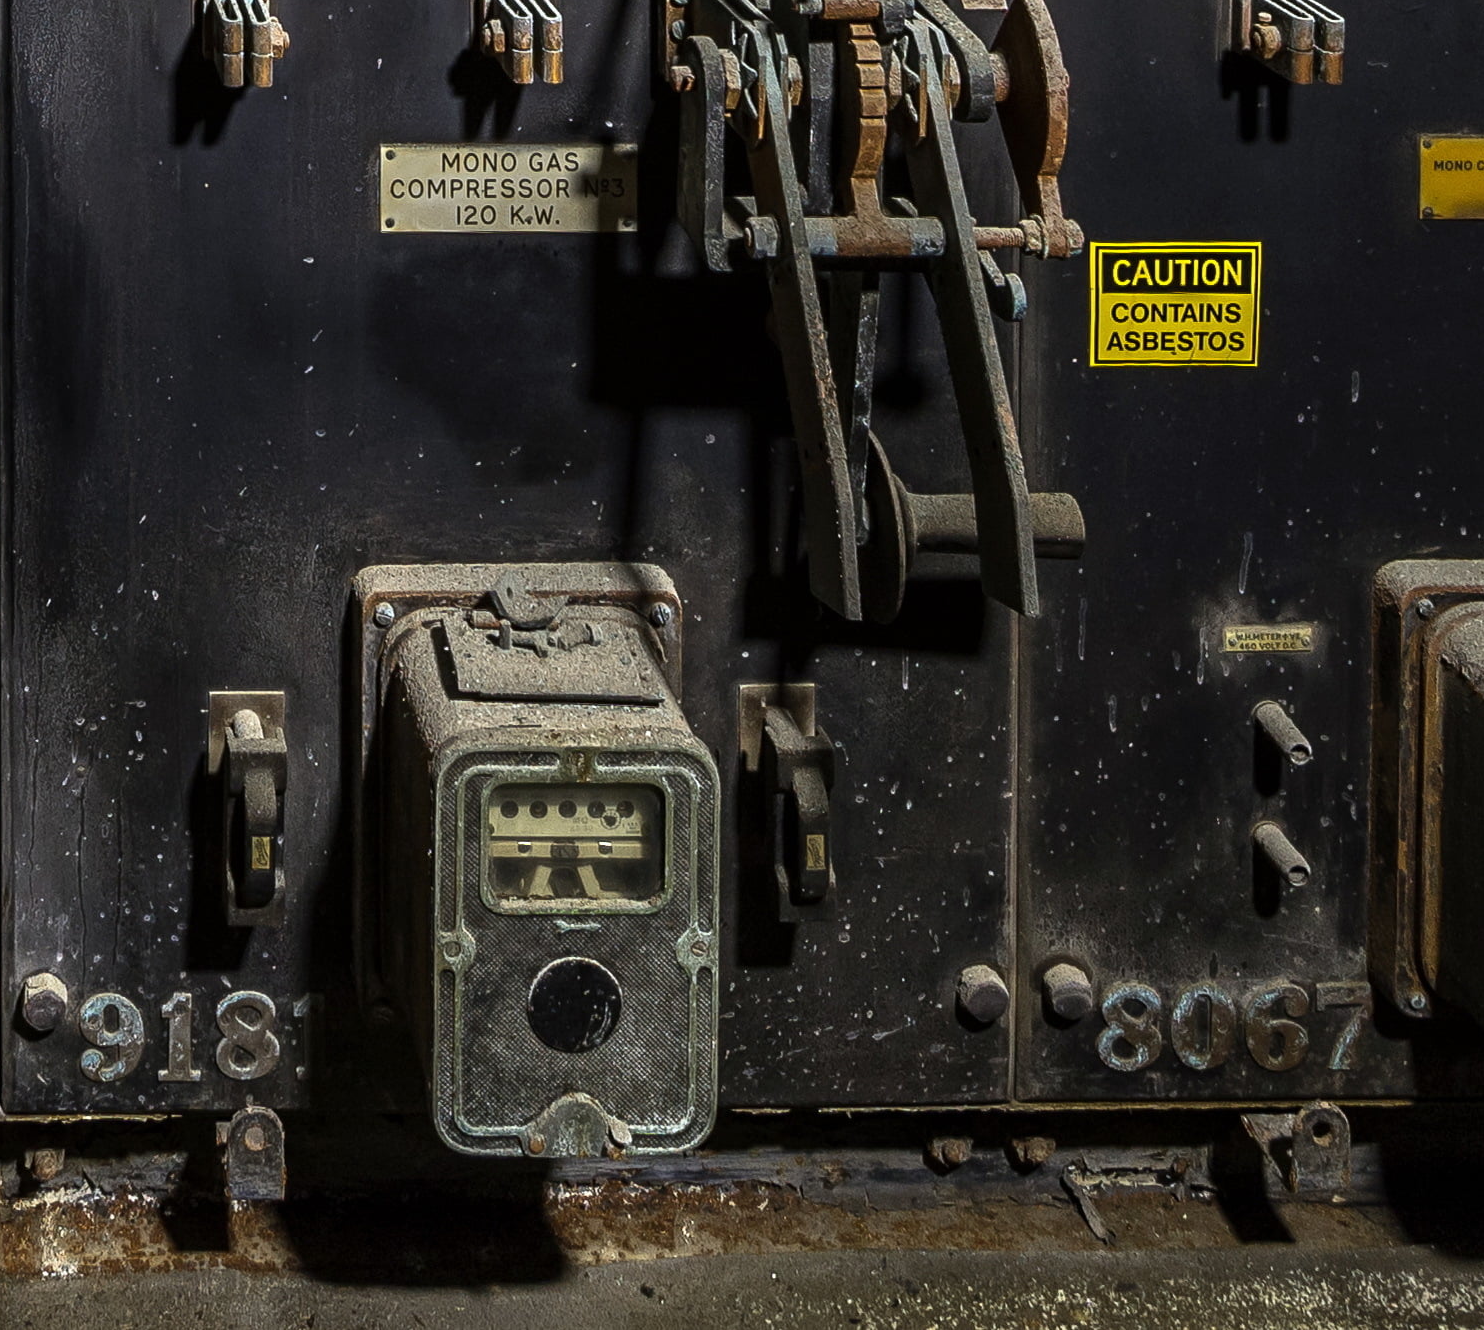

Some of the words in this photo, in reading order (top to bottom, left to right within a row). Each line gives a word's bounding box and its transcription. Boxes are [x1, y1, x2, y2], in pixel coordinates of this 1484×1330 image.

[441, 152, 517, 173] MONO
[528, 152, 580, 173] GAS
[1433, 160, 1473, 172] MONO
[389, 178, 572, 199] COMPRESSOR
[456, 204, 497, 226] 120
[510, 204, 562, 226] K.W.
[1112, 259, 1243, 287] CAUTION
[1110, 302, 1242, 324] CONTAINS
[1106, 330, 1245, 353] ASBESTOS
[1239, 642, 1257, 650] 460
[1259, 642, 1281, 650] VOLT
[1095, 980, 1374, 1073] 8067
